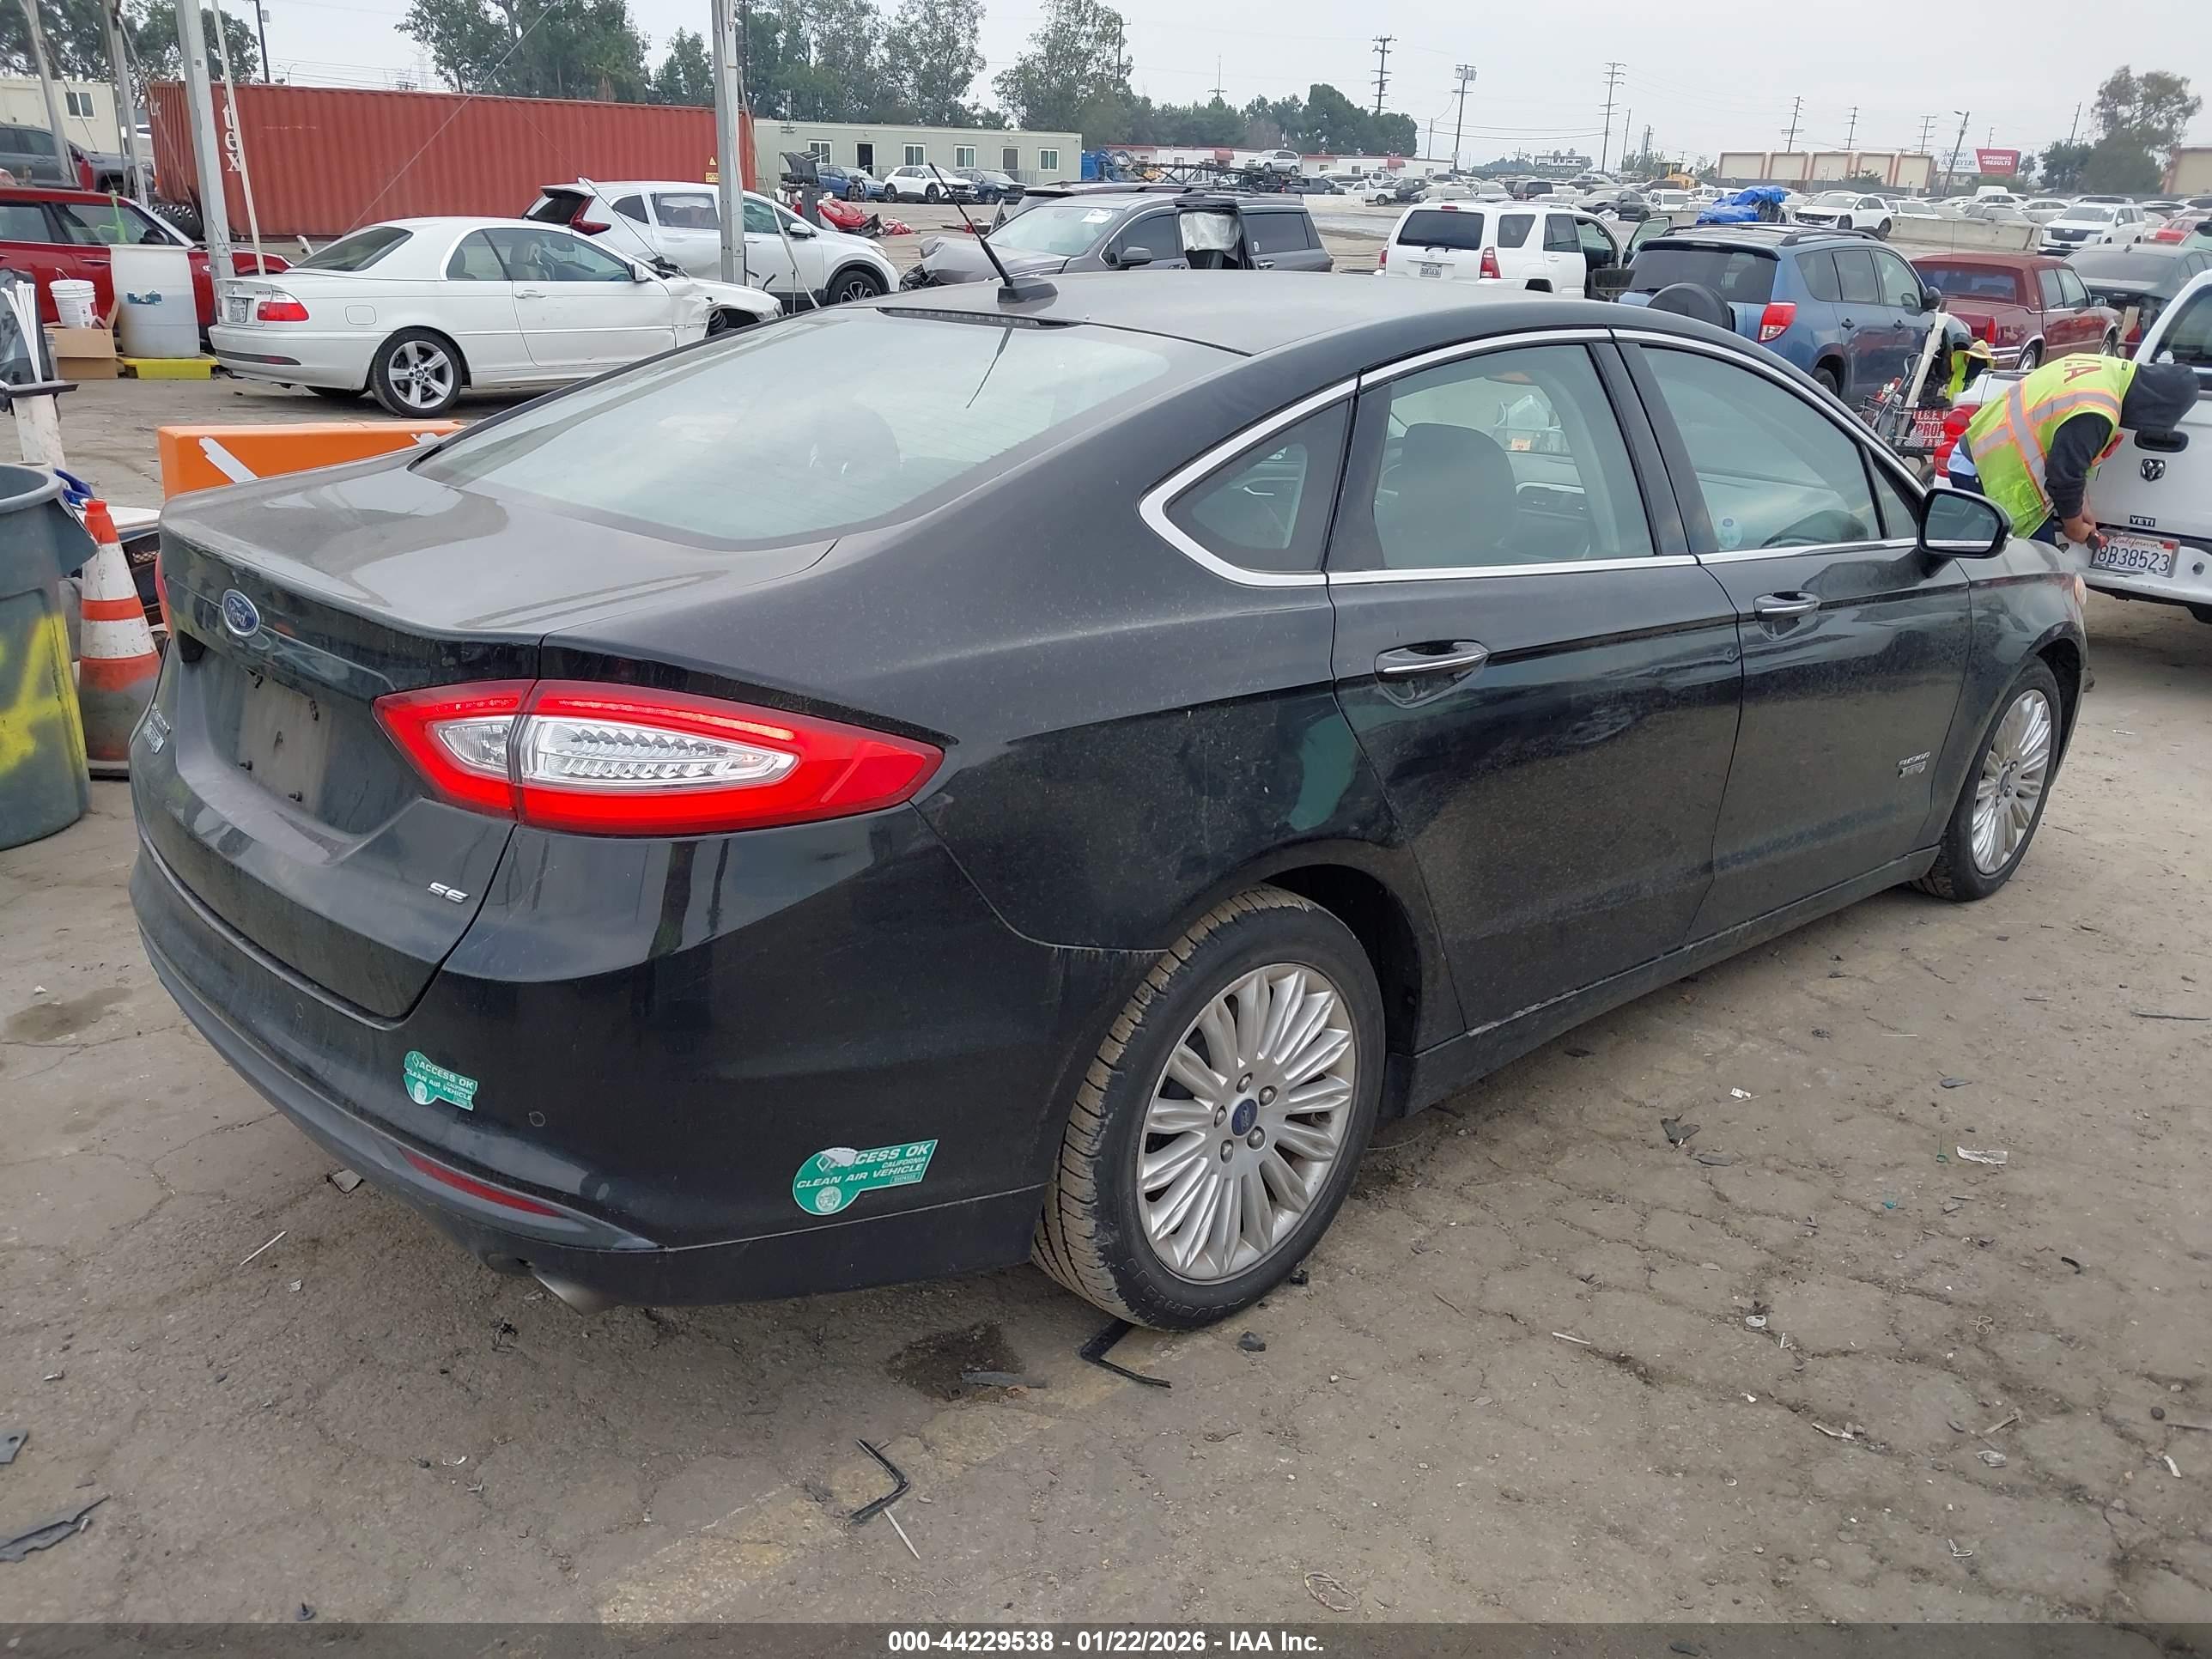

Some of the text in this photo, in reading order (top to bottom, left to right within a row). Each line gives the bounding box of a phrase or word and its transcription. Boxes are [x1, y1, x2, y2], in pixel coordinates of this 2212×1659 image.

[2131, 516, 2154, 526] YETI
[2113, 534, 2159, 548] California
[2098, 545, 2171, 572] 8B38523
[227, 597, 249, 627] Ford
[427, 882, 470, 903] SE
[419, 1060, 475, 1089] ACCESS OK
[429, 1079, 441, 1088] AIR
[443, 1084, 472, 1100] VEHICLE
[830, 1143, 932, 1169] CESS OK
[882, 1157, 927, 1169] CALIFORNIA
[797, 1163, 925, 1188] CLEAN AIR VEHICLE
